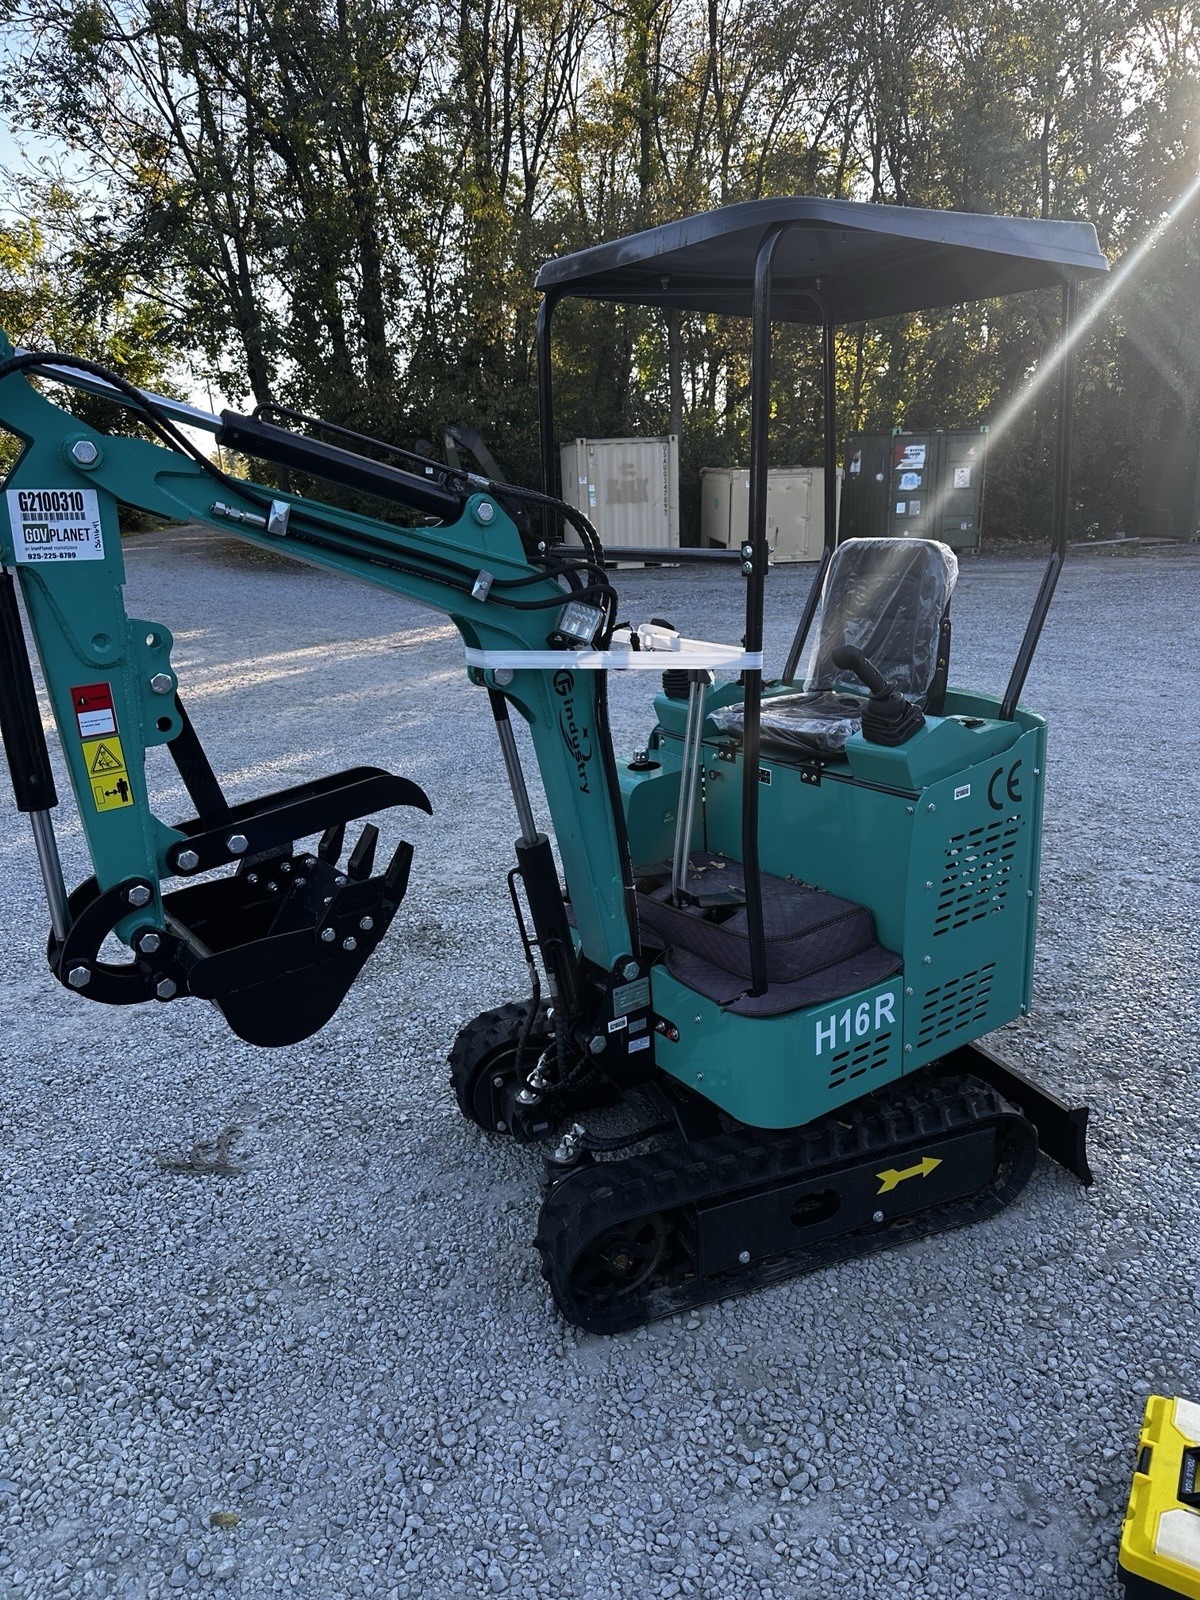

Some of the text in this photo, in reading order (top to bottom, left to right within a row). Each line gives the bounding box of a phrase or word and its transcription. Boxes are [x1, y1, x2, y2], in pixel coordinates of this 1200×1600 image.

[18, 491, 84, 512] G2100310
[27, 552, 77, 560] 925-225-8799
[816, 992, 896, 1056] H16R
[1186, 1458, 1195, 1478] TOOLS
